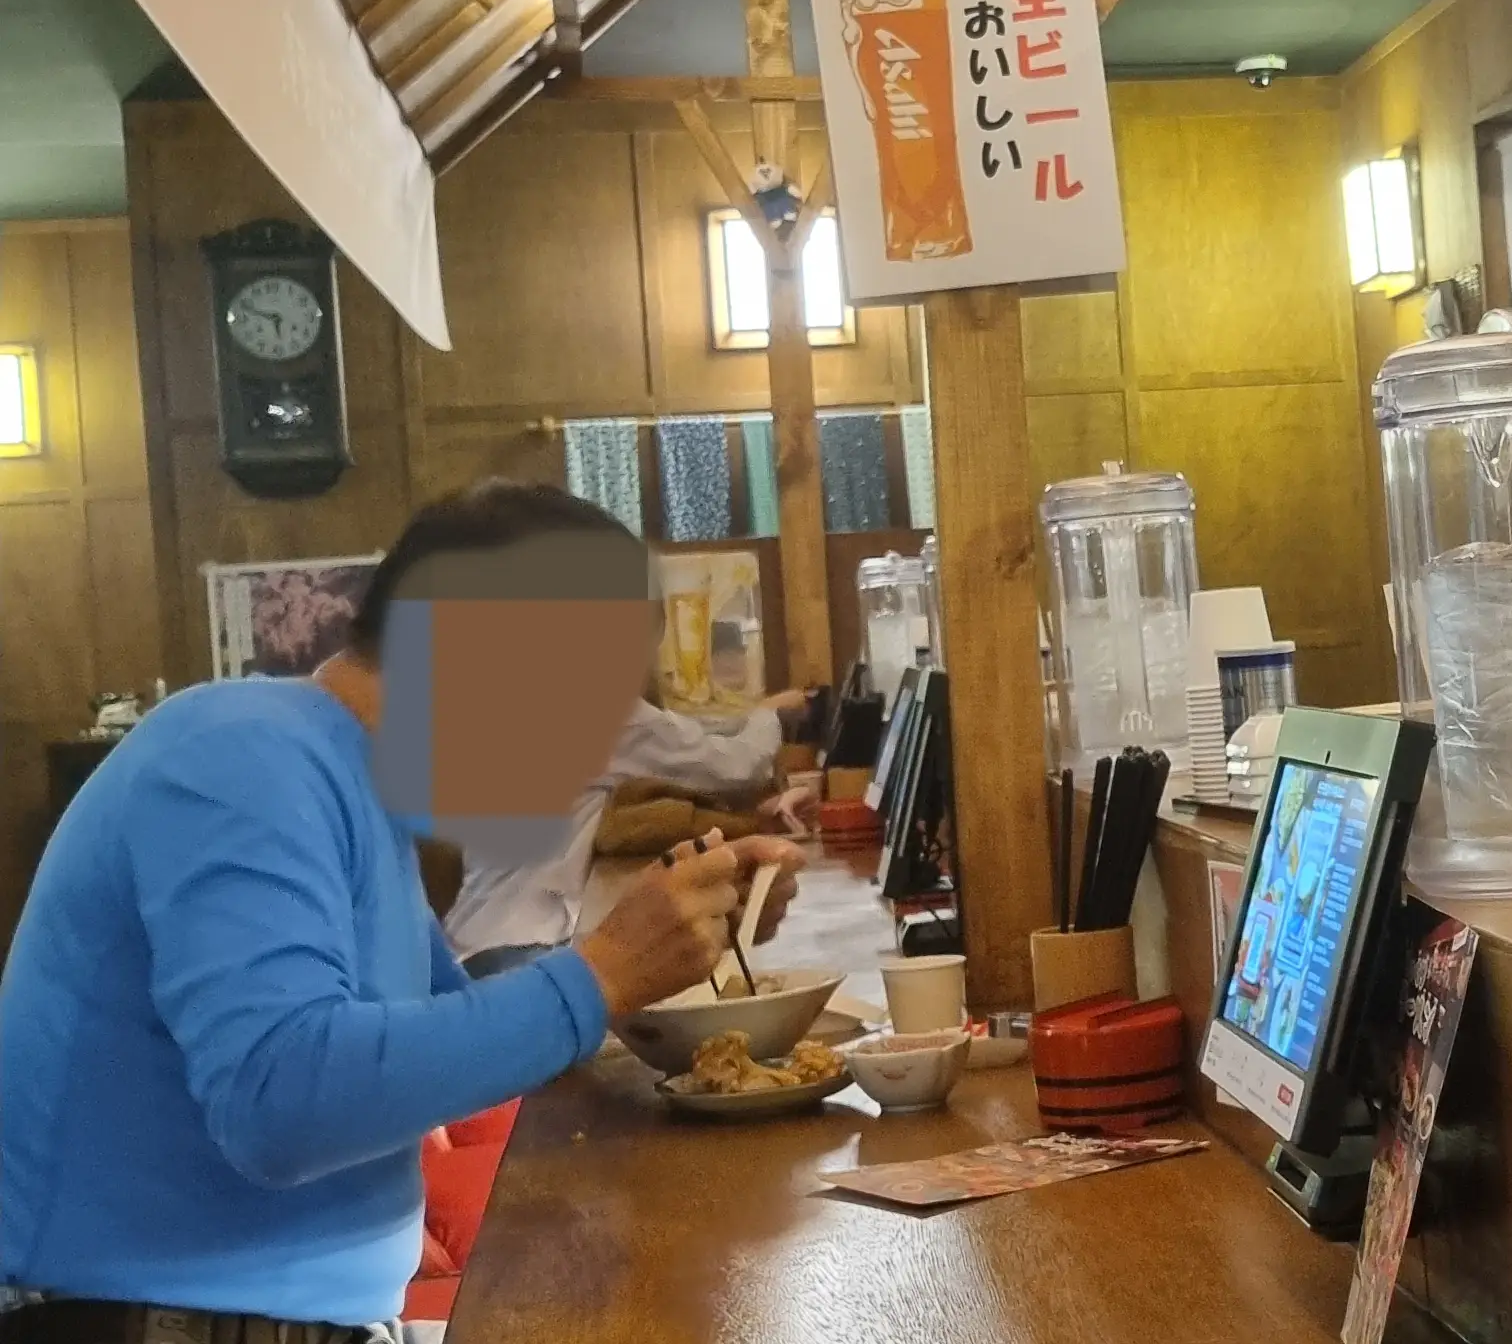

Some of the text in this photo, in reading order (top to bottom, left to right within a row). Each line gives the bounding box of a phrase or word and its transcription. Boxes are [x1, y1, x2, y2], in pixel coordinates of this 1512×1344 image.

[874, 28, 934, 140] Asahi
[964, 0, 1022, 179] おいしい
